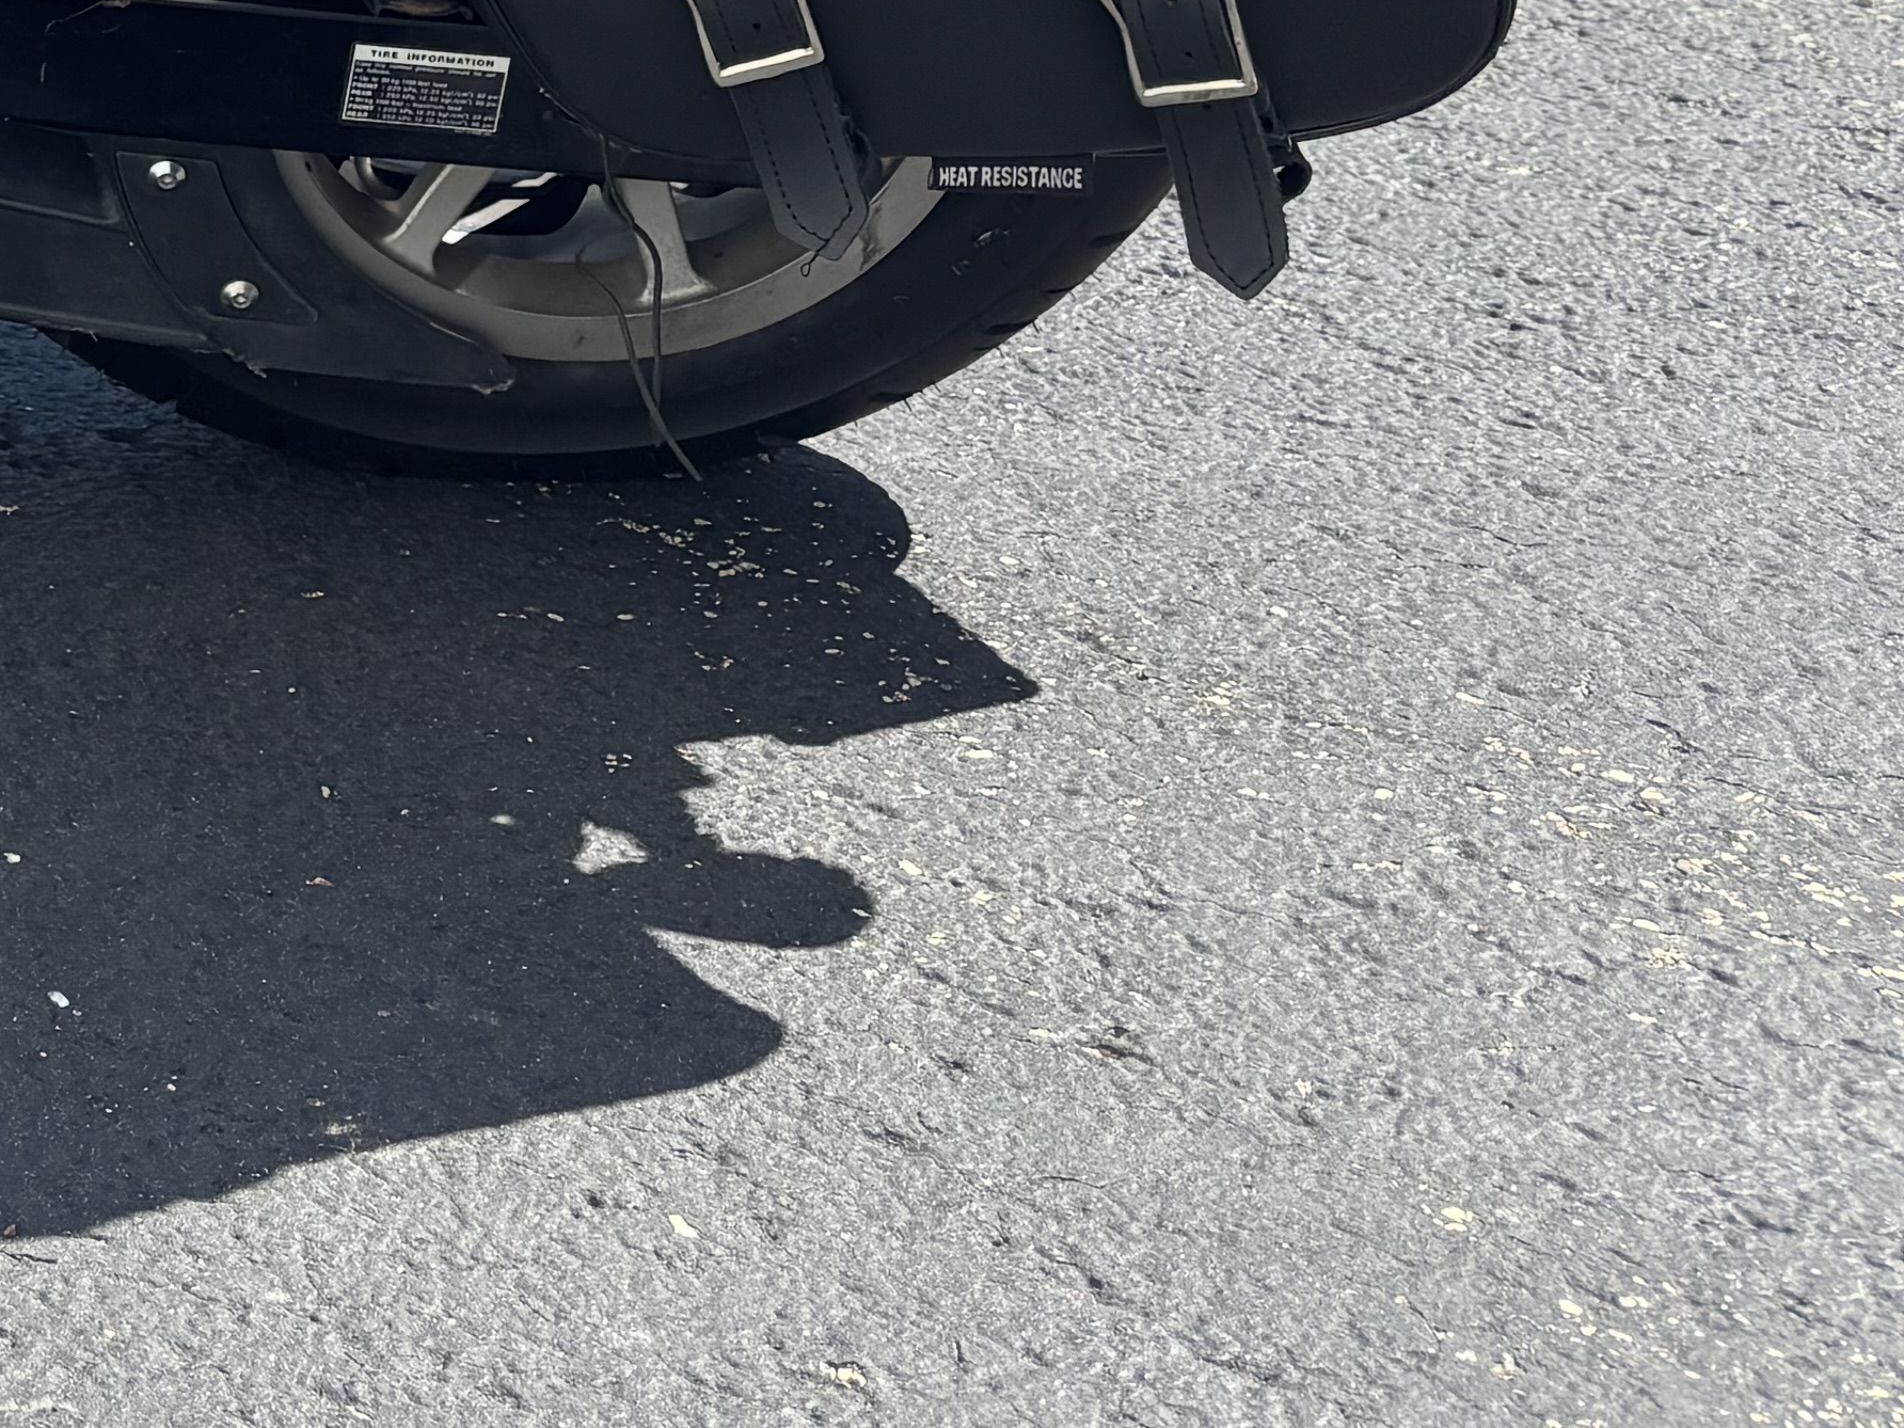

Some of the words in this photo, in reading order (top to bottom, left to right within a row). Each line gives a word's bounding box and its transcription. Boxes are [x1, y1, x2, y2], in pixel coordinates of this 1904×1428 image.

[370, 49, 399, 59] TIRE
[406, 52, 496, 68] INFORMATION
[939, 166, 978, 188] HEAT
[981, 166, 1083, 189] RESISTANCE
